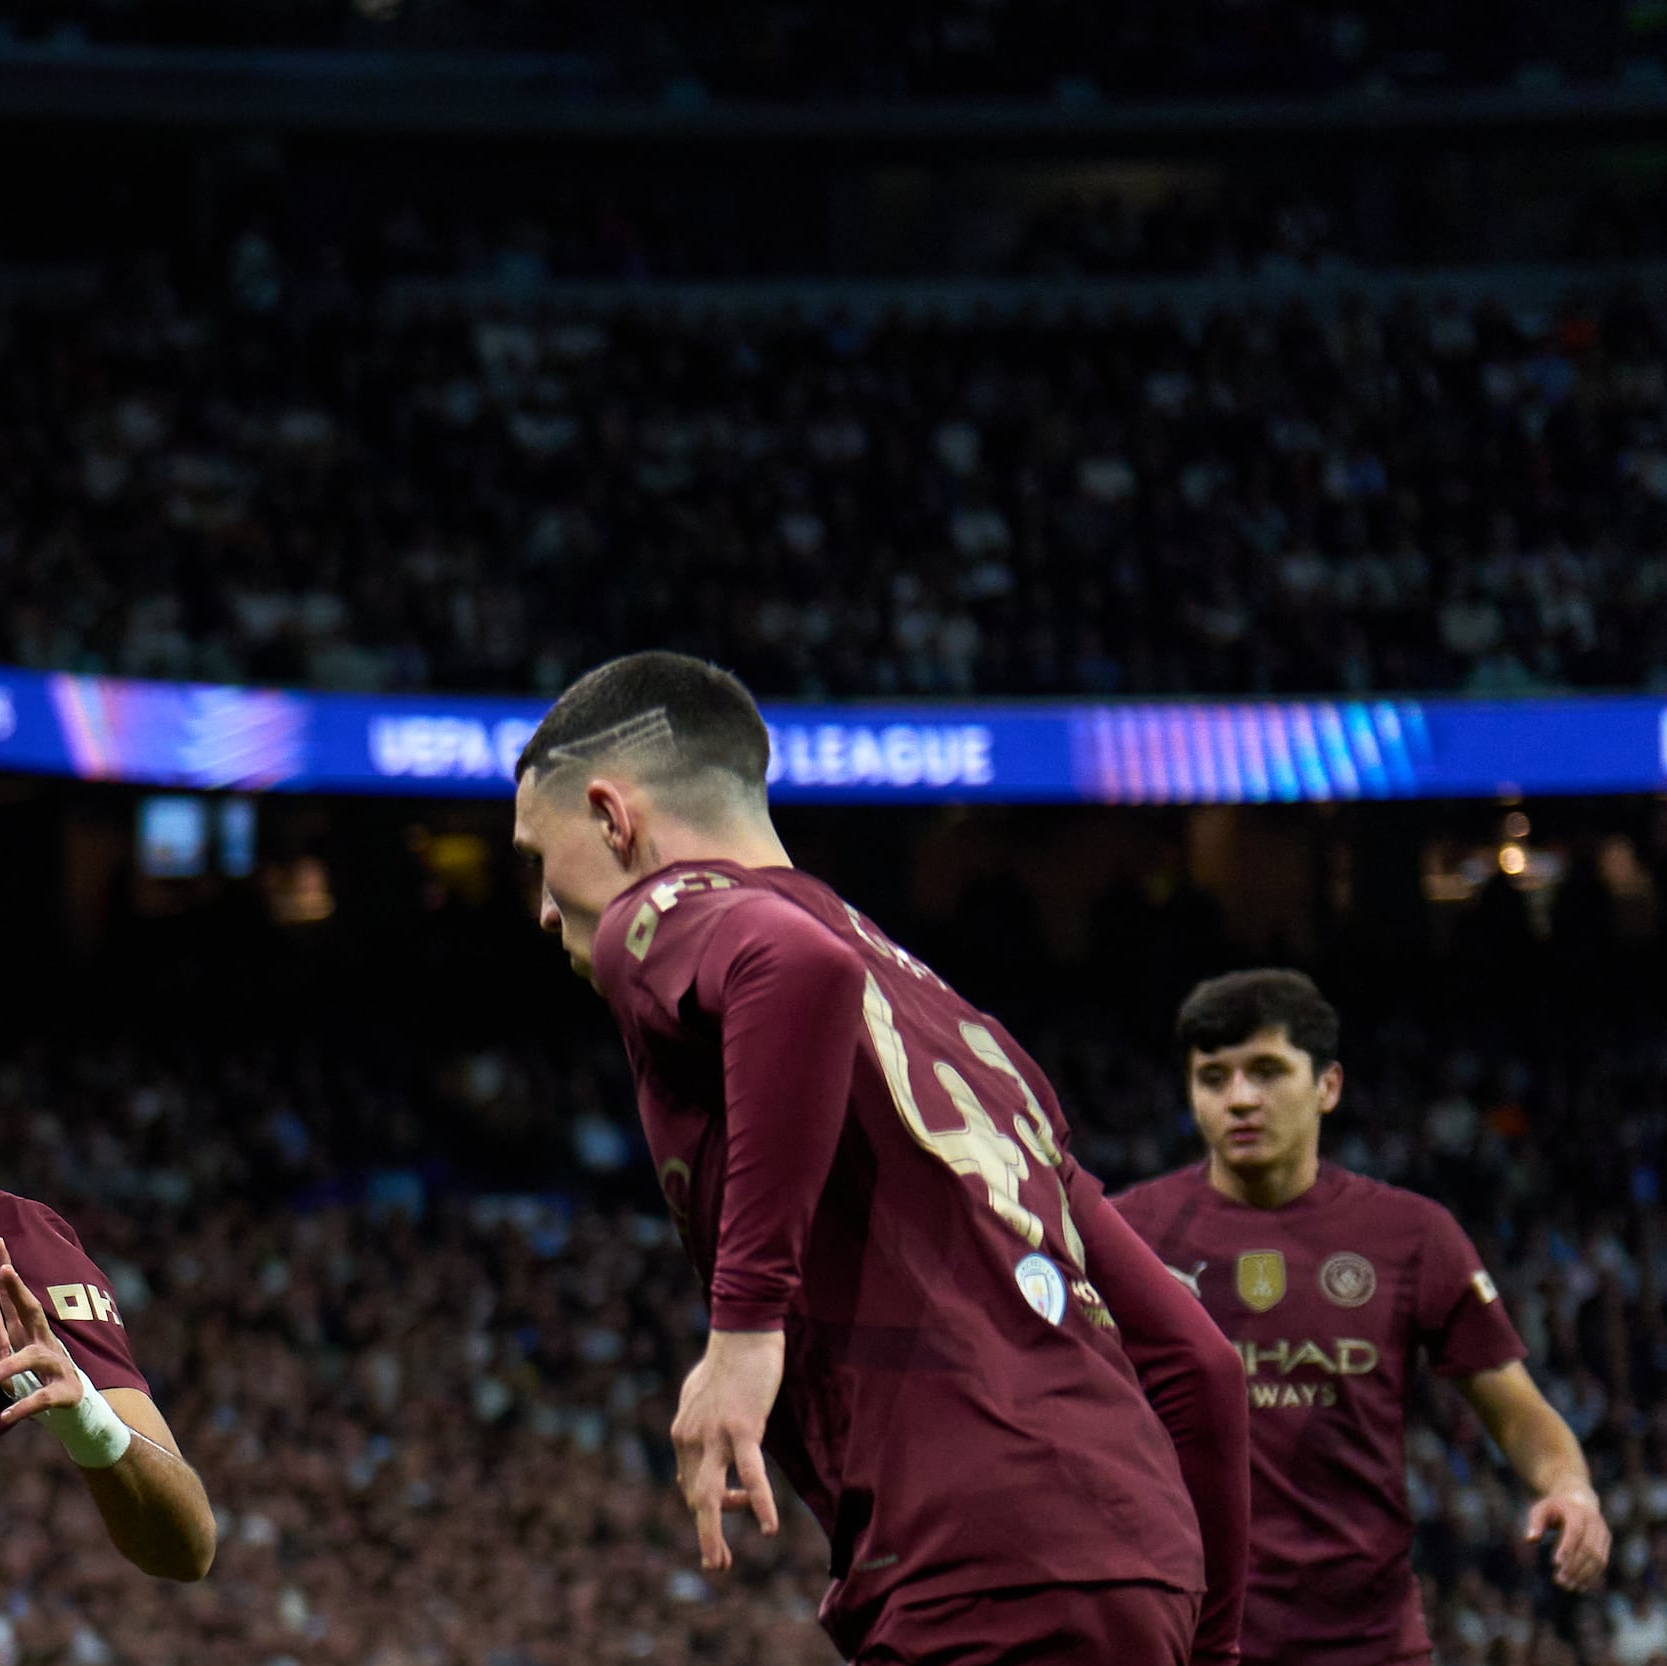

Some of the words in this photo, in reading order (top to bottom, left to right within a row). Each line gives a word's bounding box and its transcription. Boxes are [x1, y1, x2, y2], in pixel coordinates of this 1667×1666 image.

[790, 724, 994, 787] LEAGUE
[1234, 1338, 1380, 1376] HAD
[1247, 1380, 1338, 1409] WAYS
